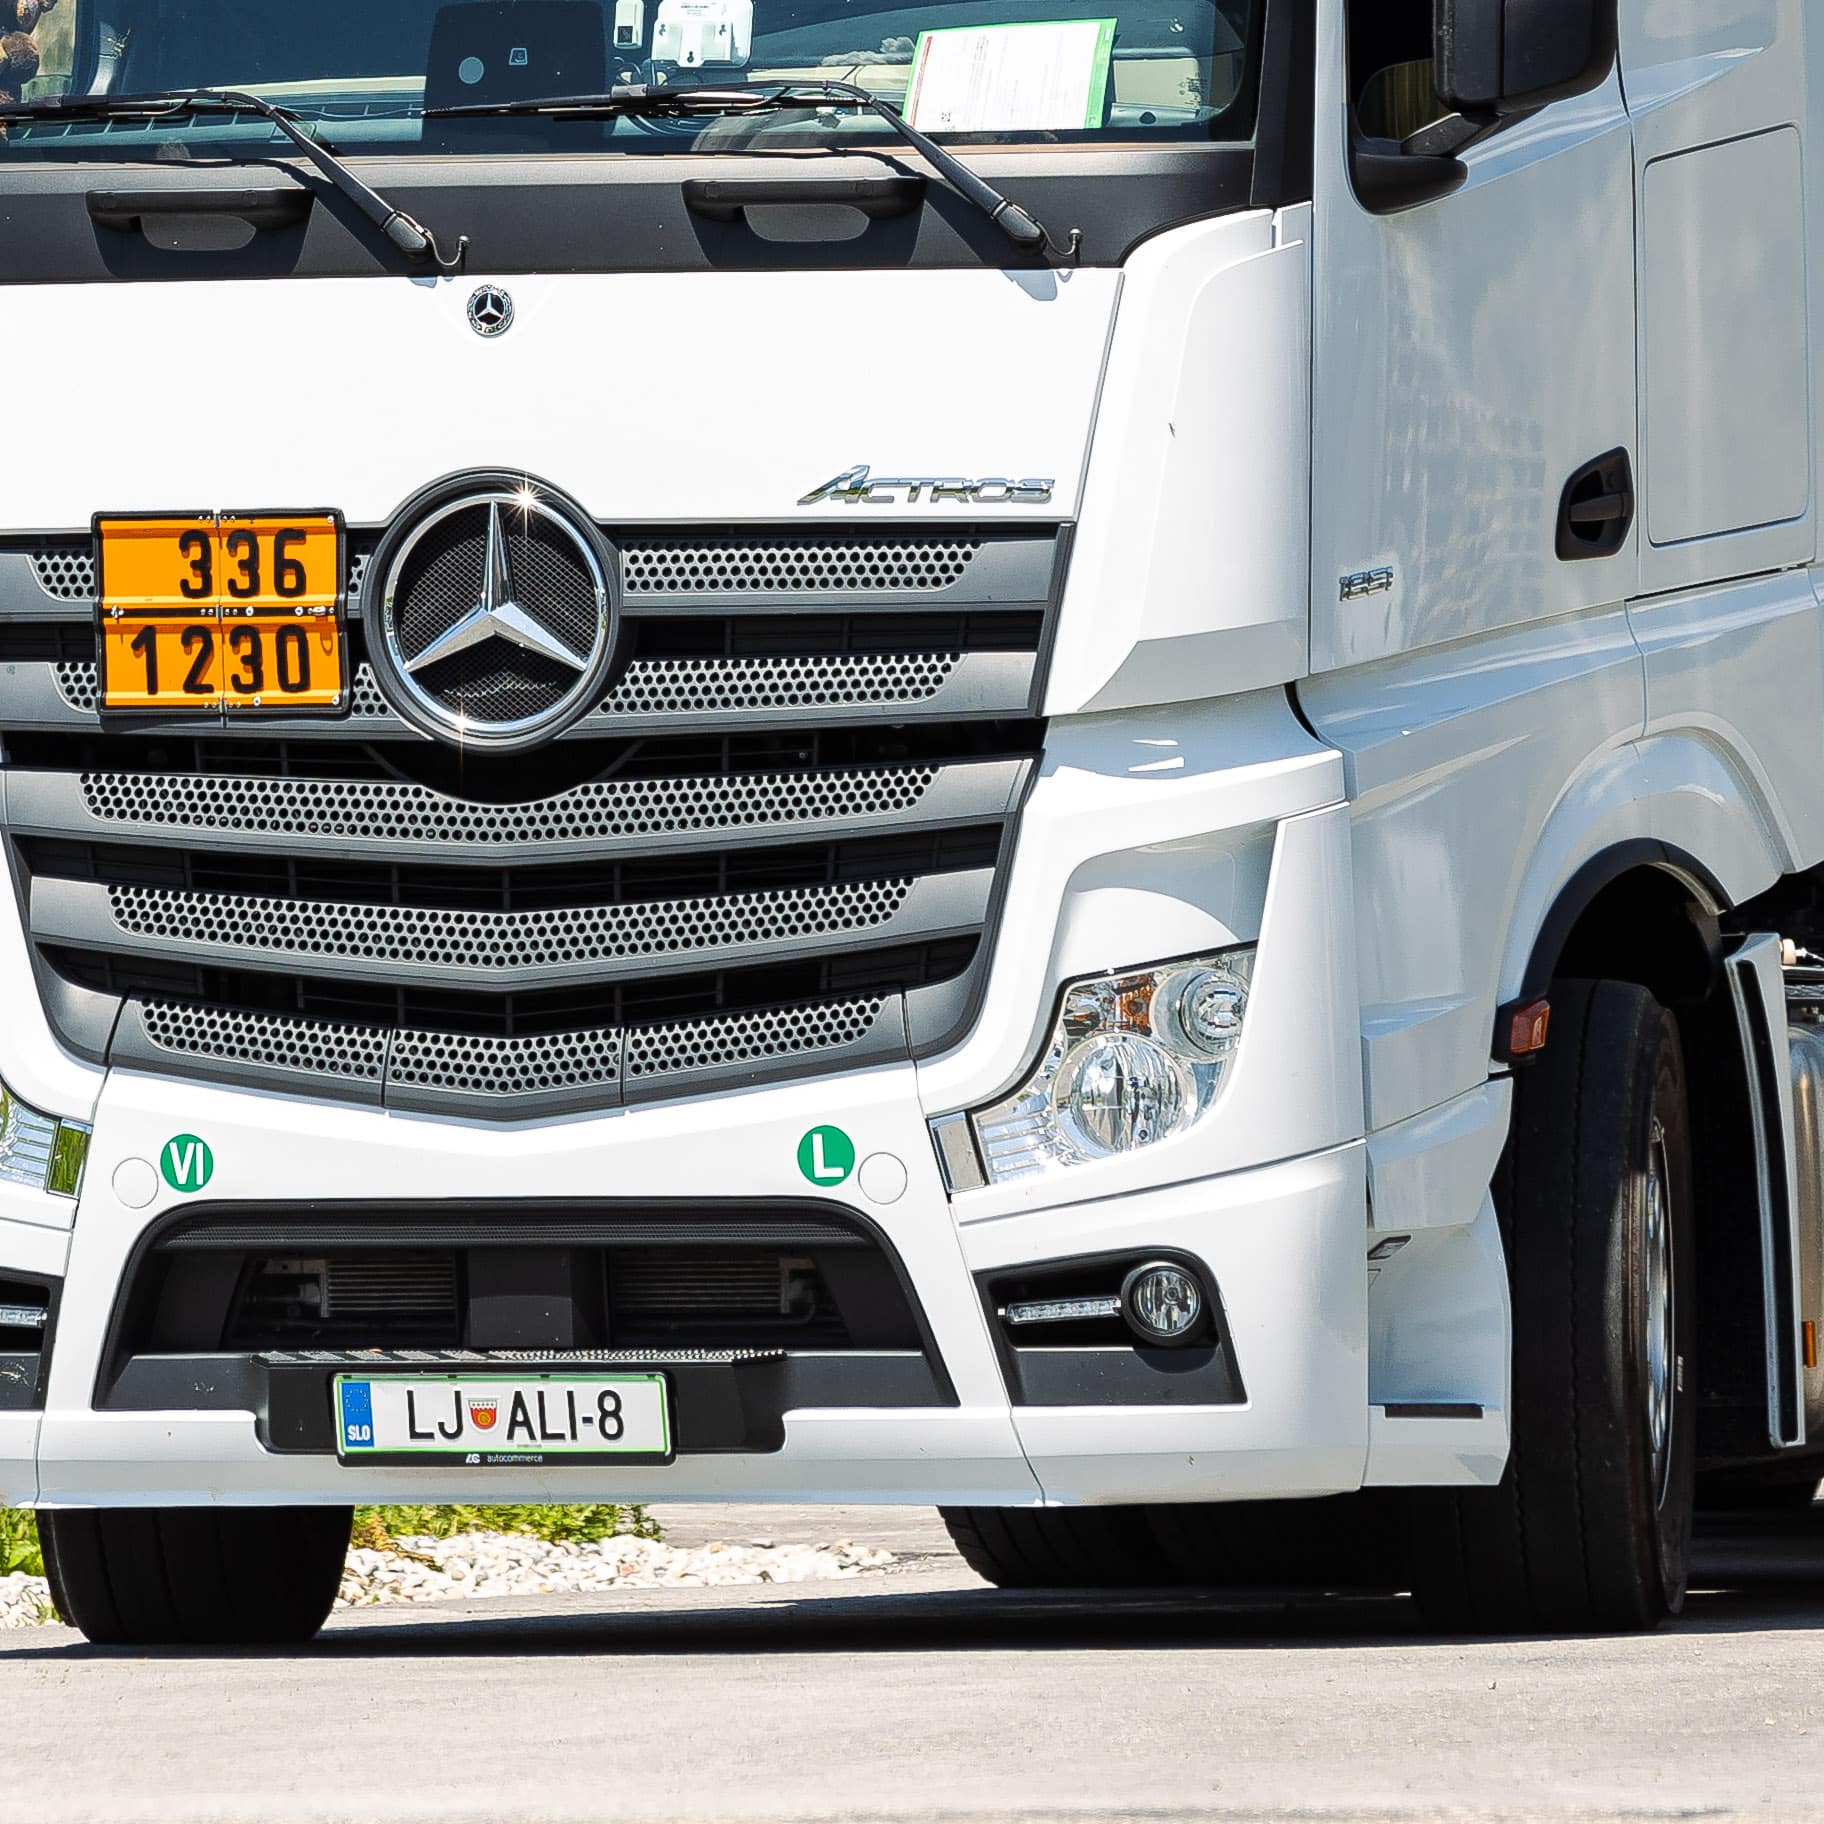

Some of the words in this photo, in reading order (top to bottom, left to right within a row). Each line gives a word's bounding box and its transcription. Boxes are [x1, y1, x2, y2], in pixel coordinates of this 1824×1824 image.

[796, 464, 1056, 506] ACTROS
[178, 529, 307, 599] 336
[130, 624, 311, 695] 1230
[168, 1141, 204, 1186] VI
[811, 1132, 845, 1179] L
[347, 1425, 371, 1441] SLO
[406, 1389, 465, 1441] LJ
[505, 1389, 625, 1442] ALI-8
[486, 1453, 543, 1464] autocommerce
